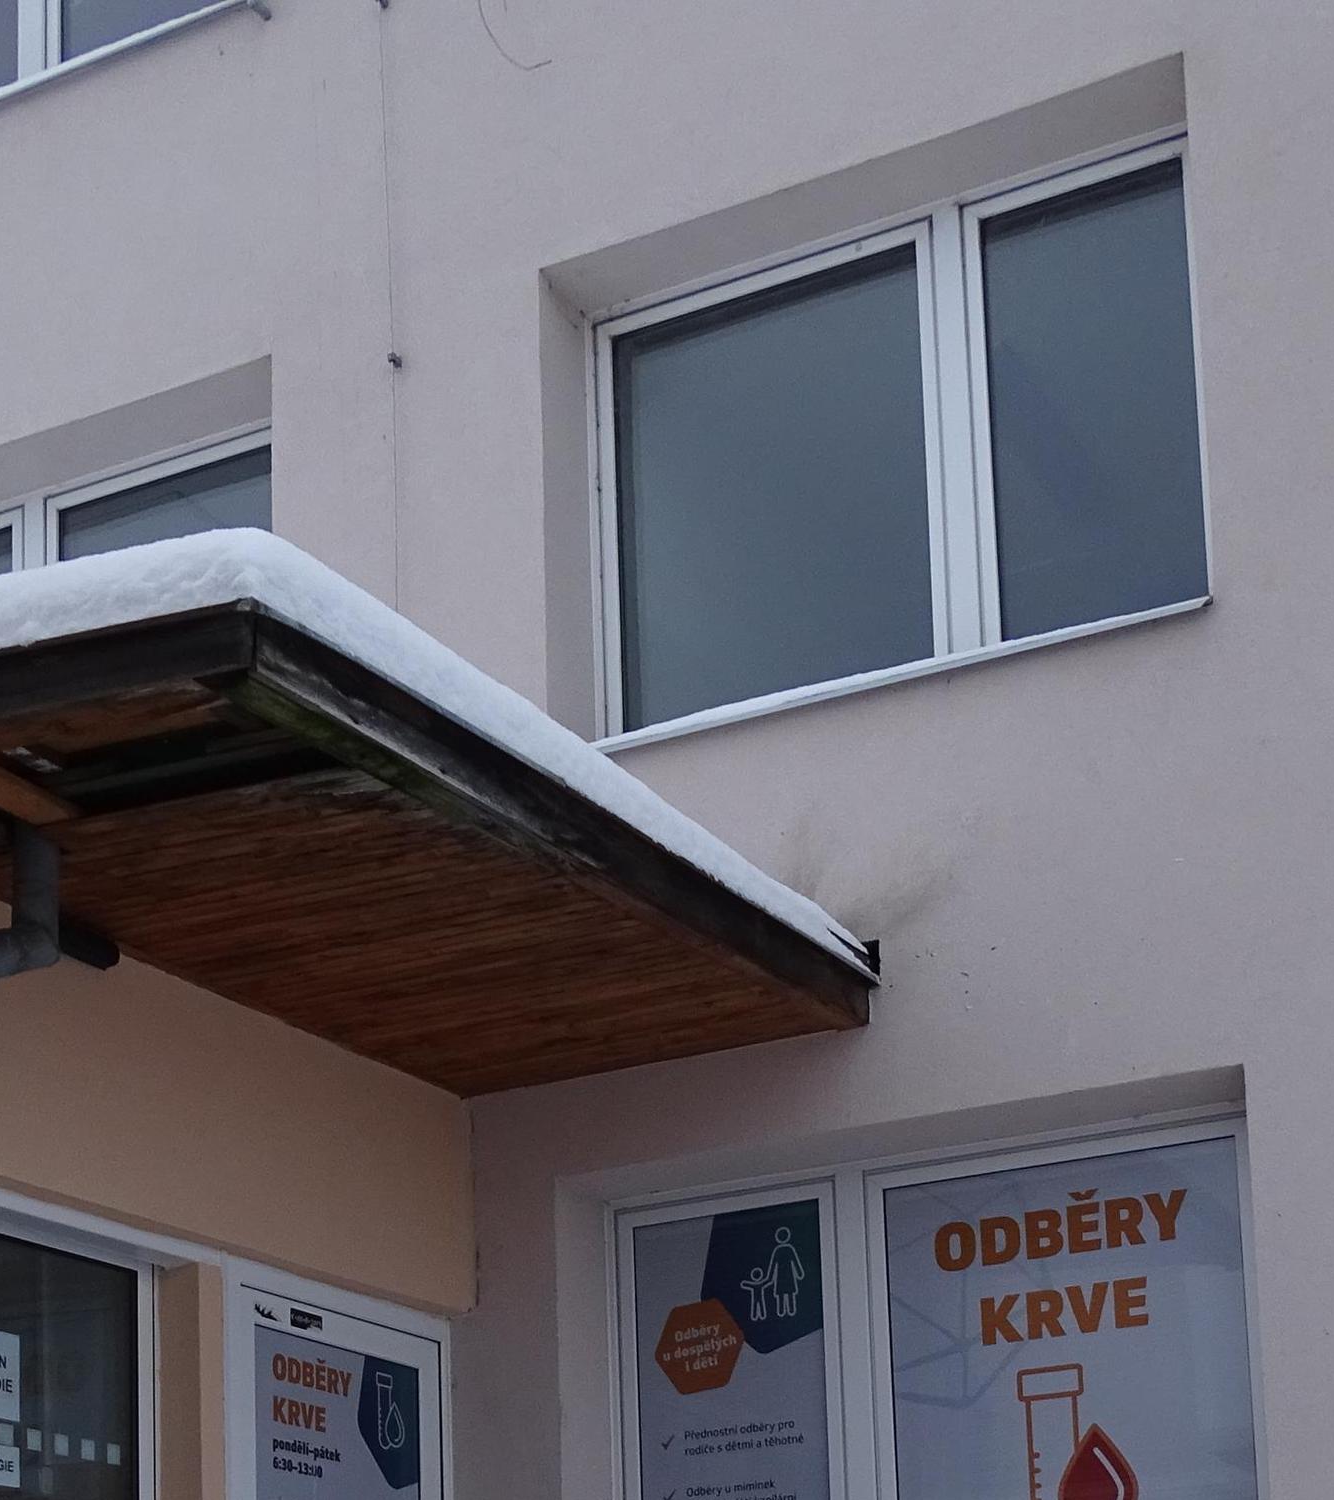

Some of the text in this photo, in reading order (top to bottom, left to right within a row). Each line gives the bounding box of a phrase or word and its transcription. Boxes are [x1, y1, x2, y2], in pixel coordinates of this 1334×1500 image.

[934, 1188, 1187, 1272] ODBĚRY
[980, 1276, 1149, 1346] KRVE
[675, 1323, 720, 1342] Odběry
[663, 1334, 737, 1361] u dospělých
[273, 1353, 352, 1397] ODBĚRY
[273, 1396, 326, 1433] KRVE
[684, 1420, 795, 1440] Přednostní odběry pro
[684, 1445, 715, 1456] rodiče
[725, 1440, 754, 1452] dětmi
[764, 1433, 804, 1447] těhotné
[686, 1485, 722, 1497] Odběry
[733, 1479, 776, 1492] miminek
